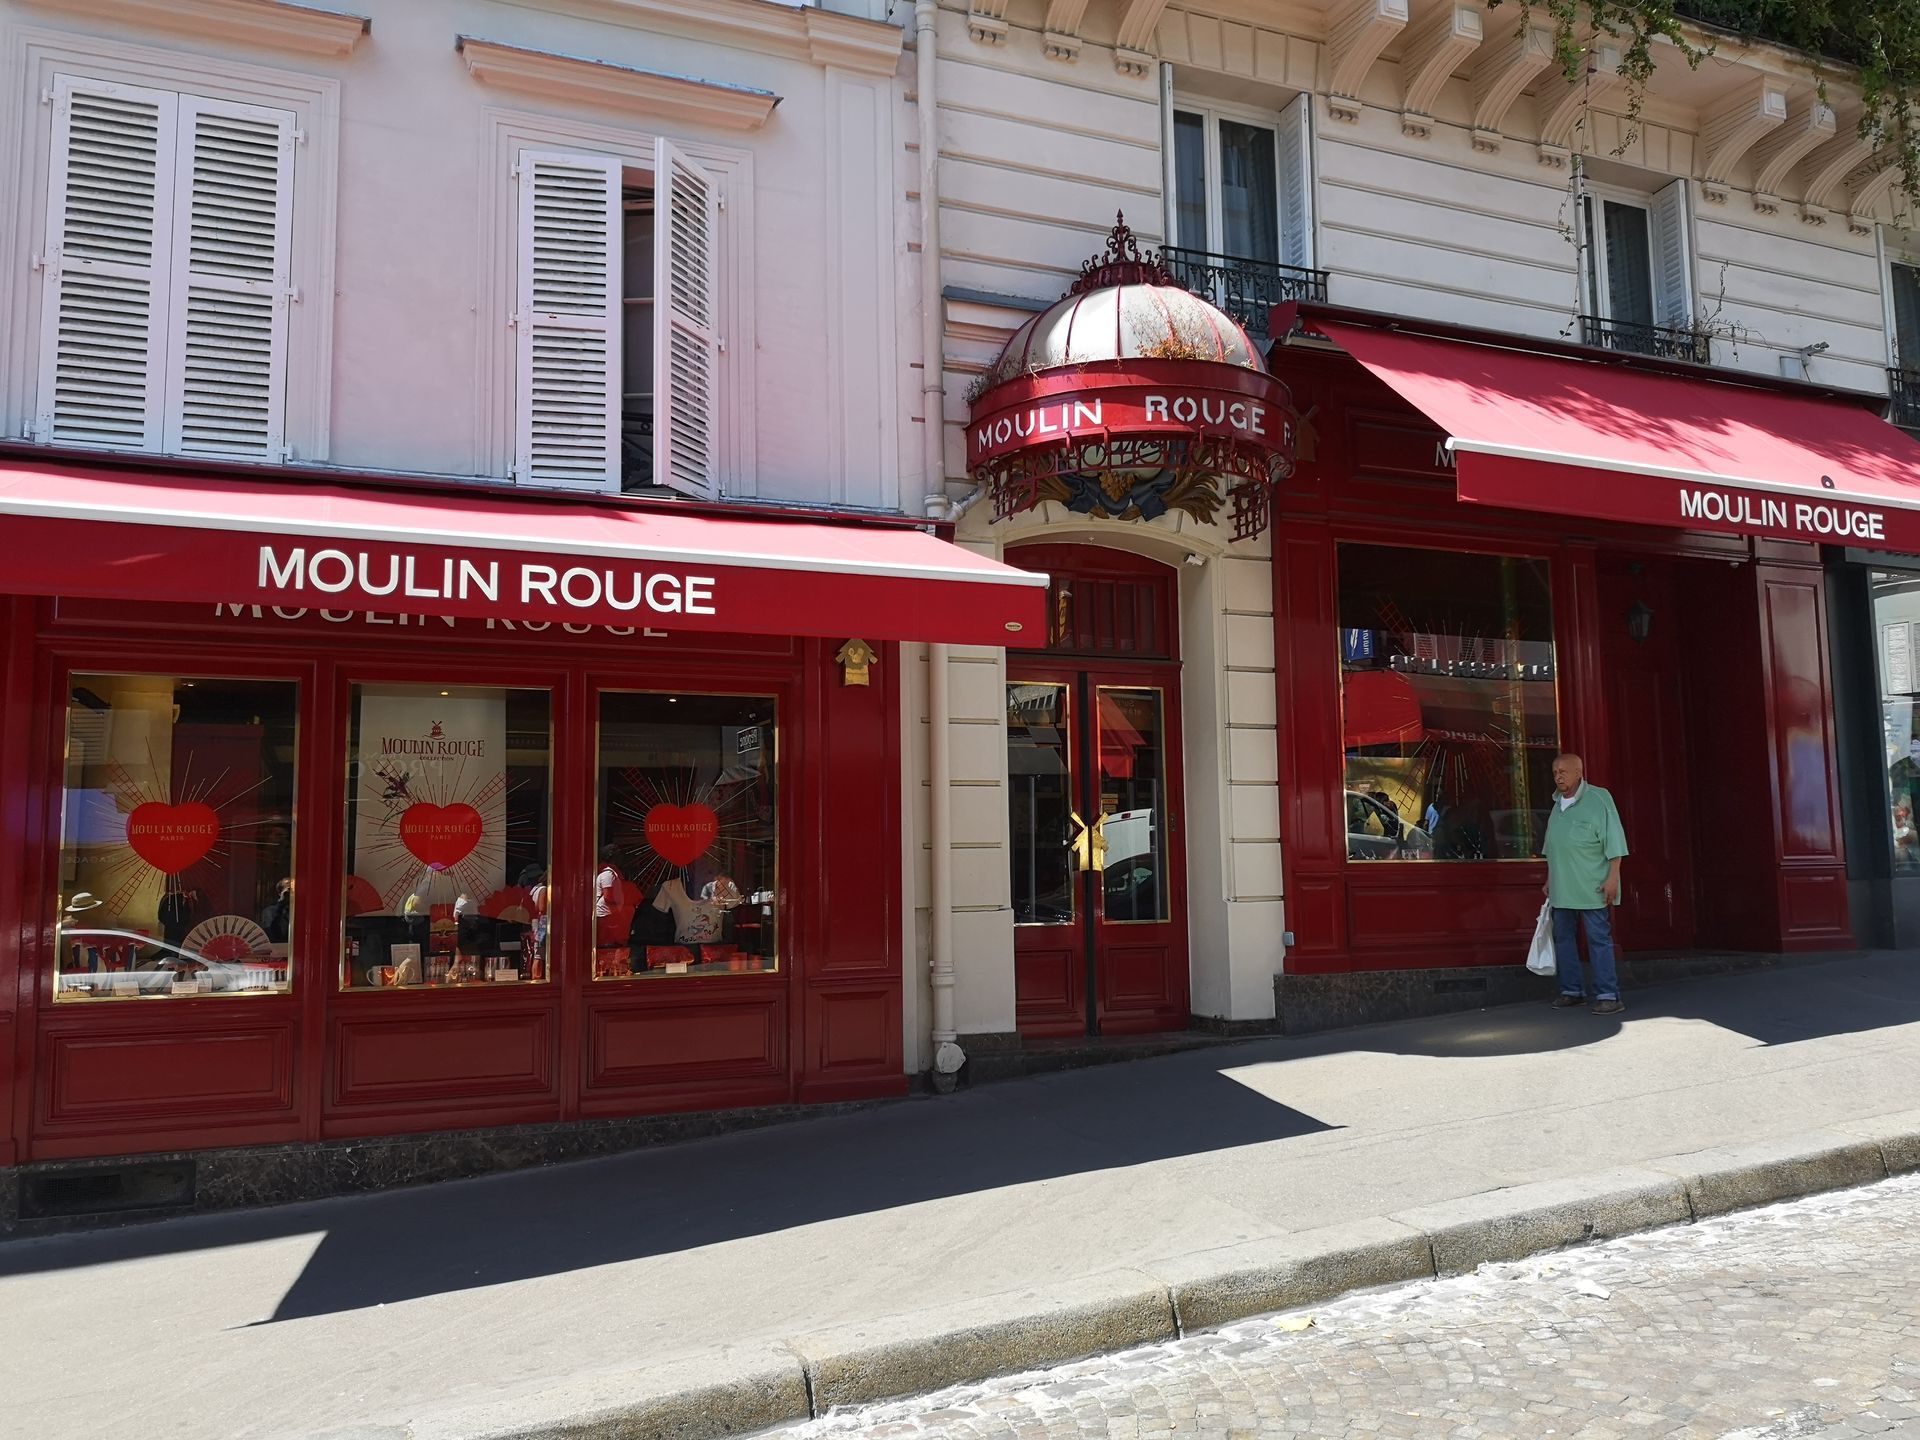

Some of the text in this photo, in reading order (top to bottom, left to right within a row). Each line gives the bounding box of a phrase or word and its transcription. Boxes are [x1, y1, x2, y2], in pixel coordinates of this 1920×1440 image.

[979, 398, 1102, 453] MOULIN
[1145, 395, 1265, 435] ROUGE
[1680, 489, 1885, 540] MOULIN ROUGE
[258, 546, 716, 615] MOULIN ROUGE
[382, 737, 485, 757] MOULIN ROUGE
[131, 824, 213, 835] MOULIN ROUGE
[404, 824, 477, 834] MOULIN ROUGE
[648, 823, 713, 833] MOULIN ROUGE
